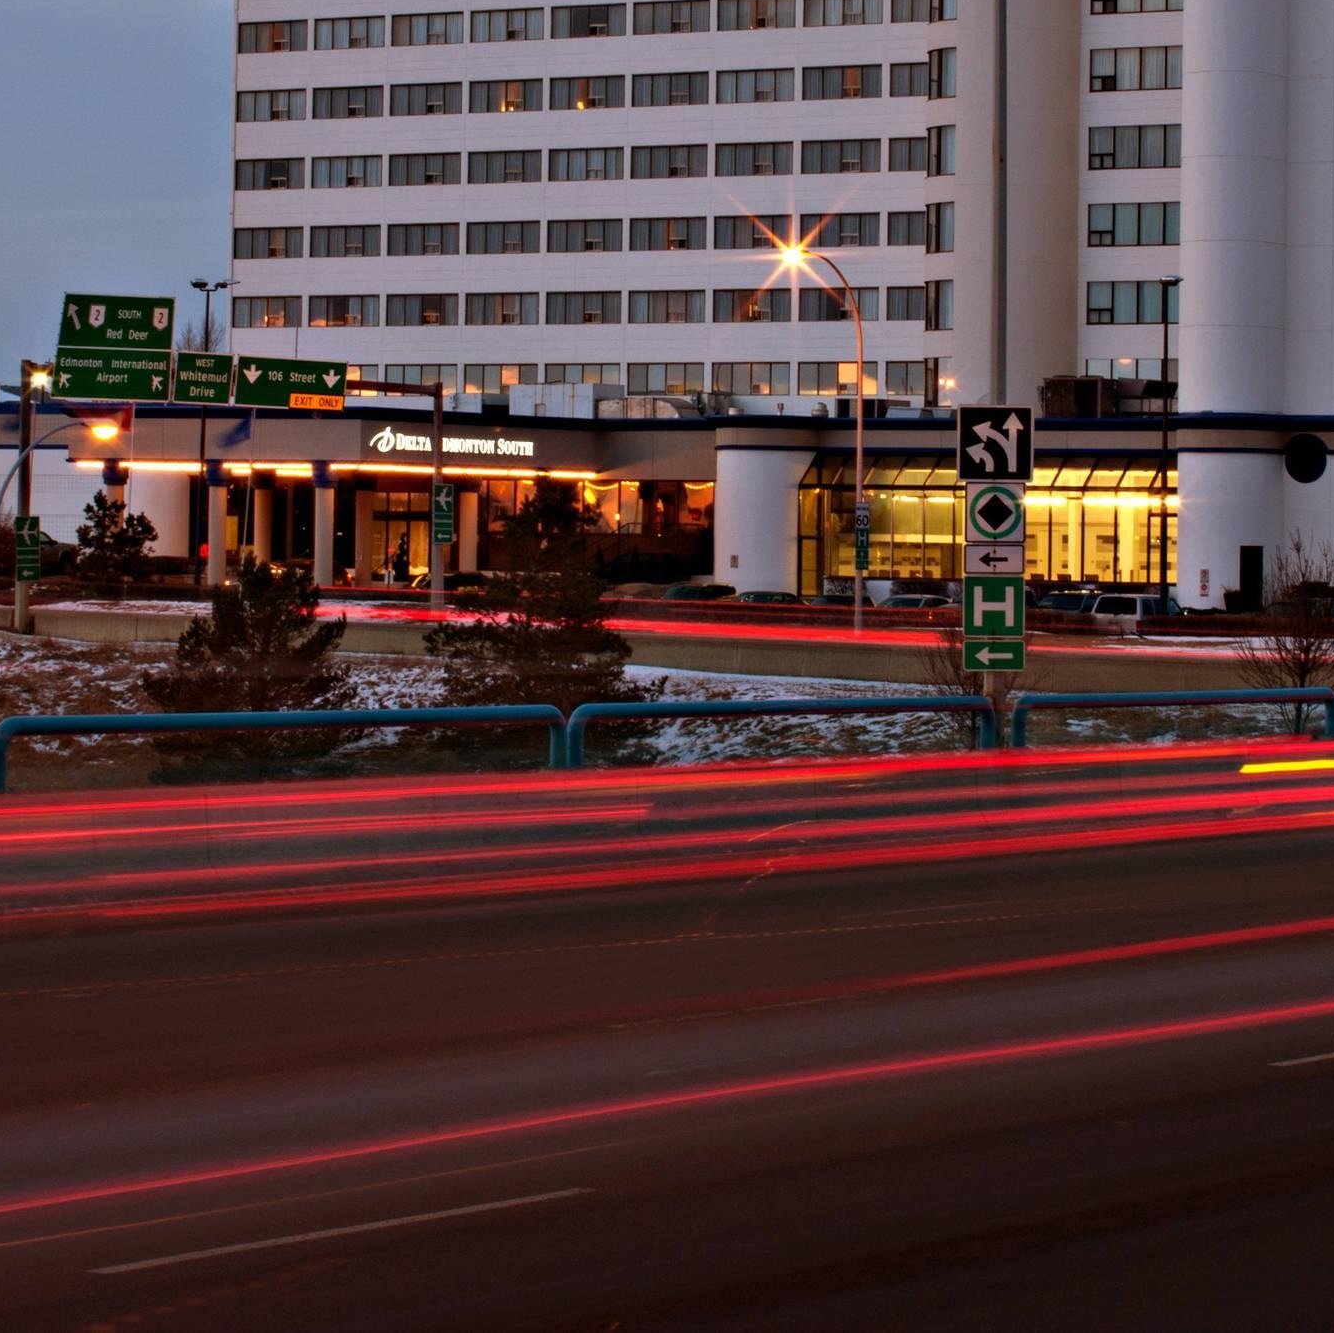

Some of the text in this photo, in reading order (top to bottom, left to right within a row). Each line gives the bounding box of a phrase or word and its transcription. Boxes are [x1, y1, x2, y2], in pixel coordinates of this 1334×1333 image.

[94, 309, 101, 321] 2
[117, 309, 142, 320] SOUTH
[158, 312, 164, 324] 2
[106, 328, 149, 340] Red Deer
[60, 357, 167, 371] Edmonton International
[196, 359, 215, 368] WEST
[96, 372, 128, 384] Airport
[180, 369, 228, 383] Whitemud
[268, 370, 316, 383] 106 Street
[190, 385, 215, 398] Drive
[294, 395, 340, 408] EXIT ONLY
[395, 433, 534, 456] DELTA DMONTON SOUTH
[856, 515, 869, 527] 60
[973, 586, 1014, 627] H
